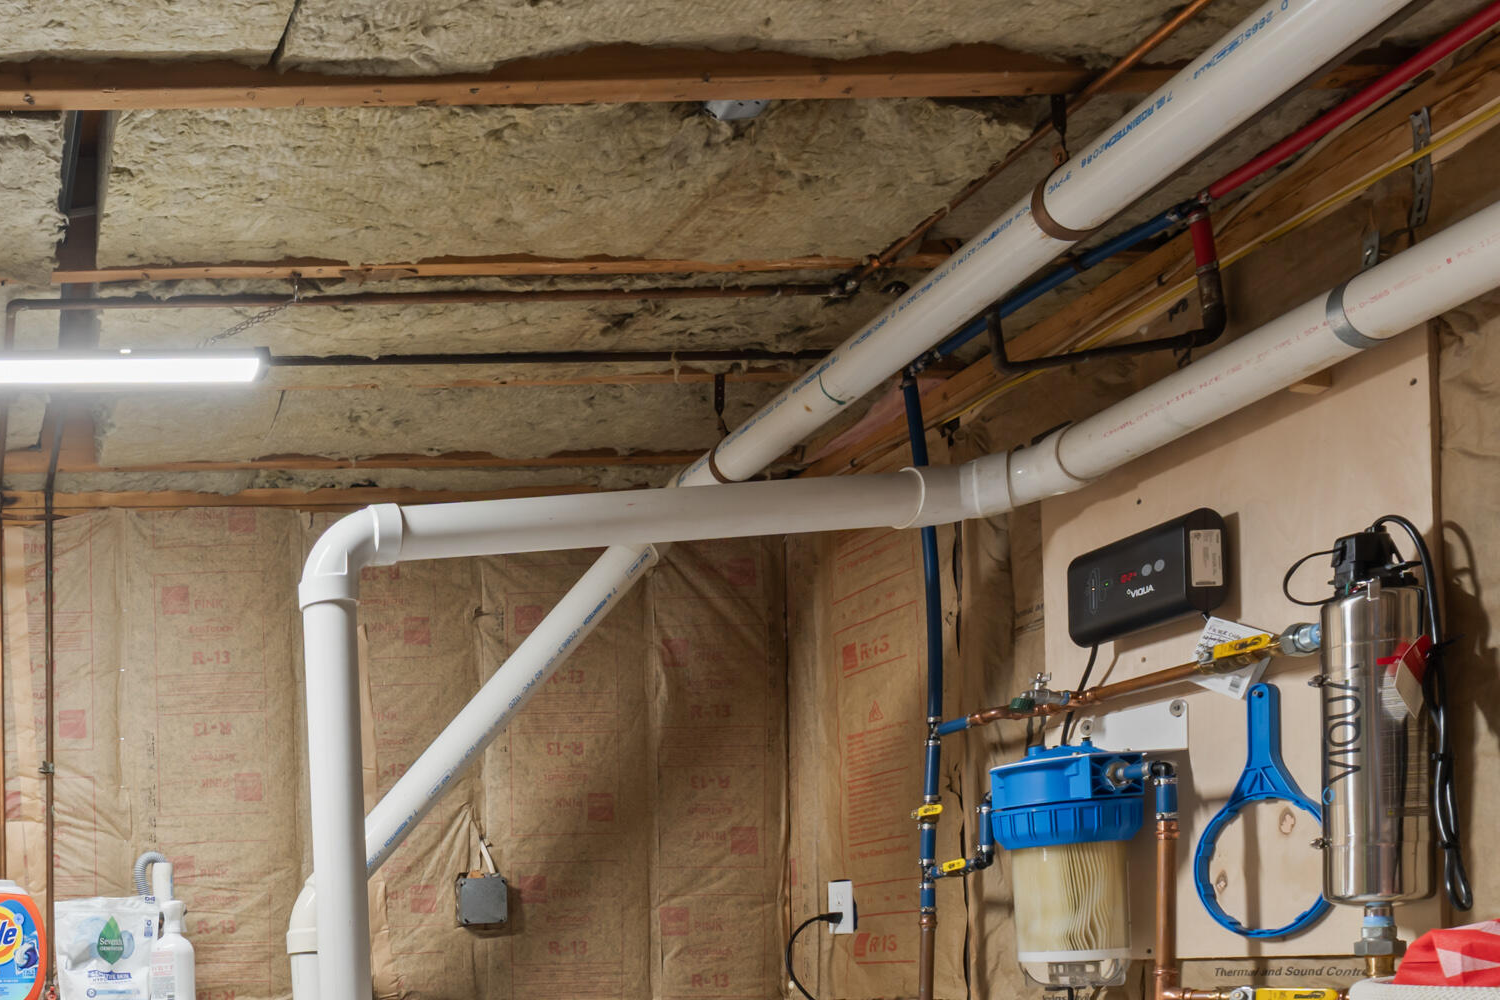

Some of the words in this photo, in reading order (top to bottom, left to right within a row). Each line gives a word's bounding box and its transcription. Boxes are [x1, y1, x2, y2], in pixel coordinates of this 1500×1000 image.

[1101, 103, 1158, 150] ROBINTECH
[1130, 584, 1155, 598] VIQUA
[193, 599, 222, 610] PINK
[191, 650, 231, 665] R-13
[690, 704, 732, 719] R-13
[193, 722, 232, 737] R-13
[1327, 663, 1361, 785] VIQUA
[547, 742, 584, 756] R-13
[201, 778, 230, 789] PINK
[690, 775, 730, 790] R-13
[197, 920, 237, 935] R-13
[548, 940, 589, 956] R-13
[1214, 967, 1258, 977] Thermal
[1285, 966, 1325, 977] Sound
[1326, 966, 1367, 977] Contro
[691, 973, 729, 988] R-13
